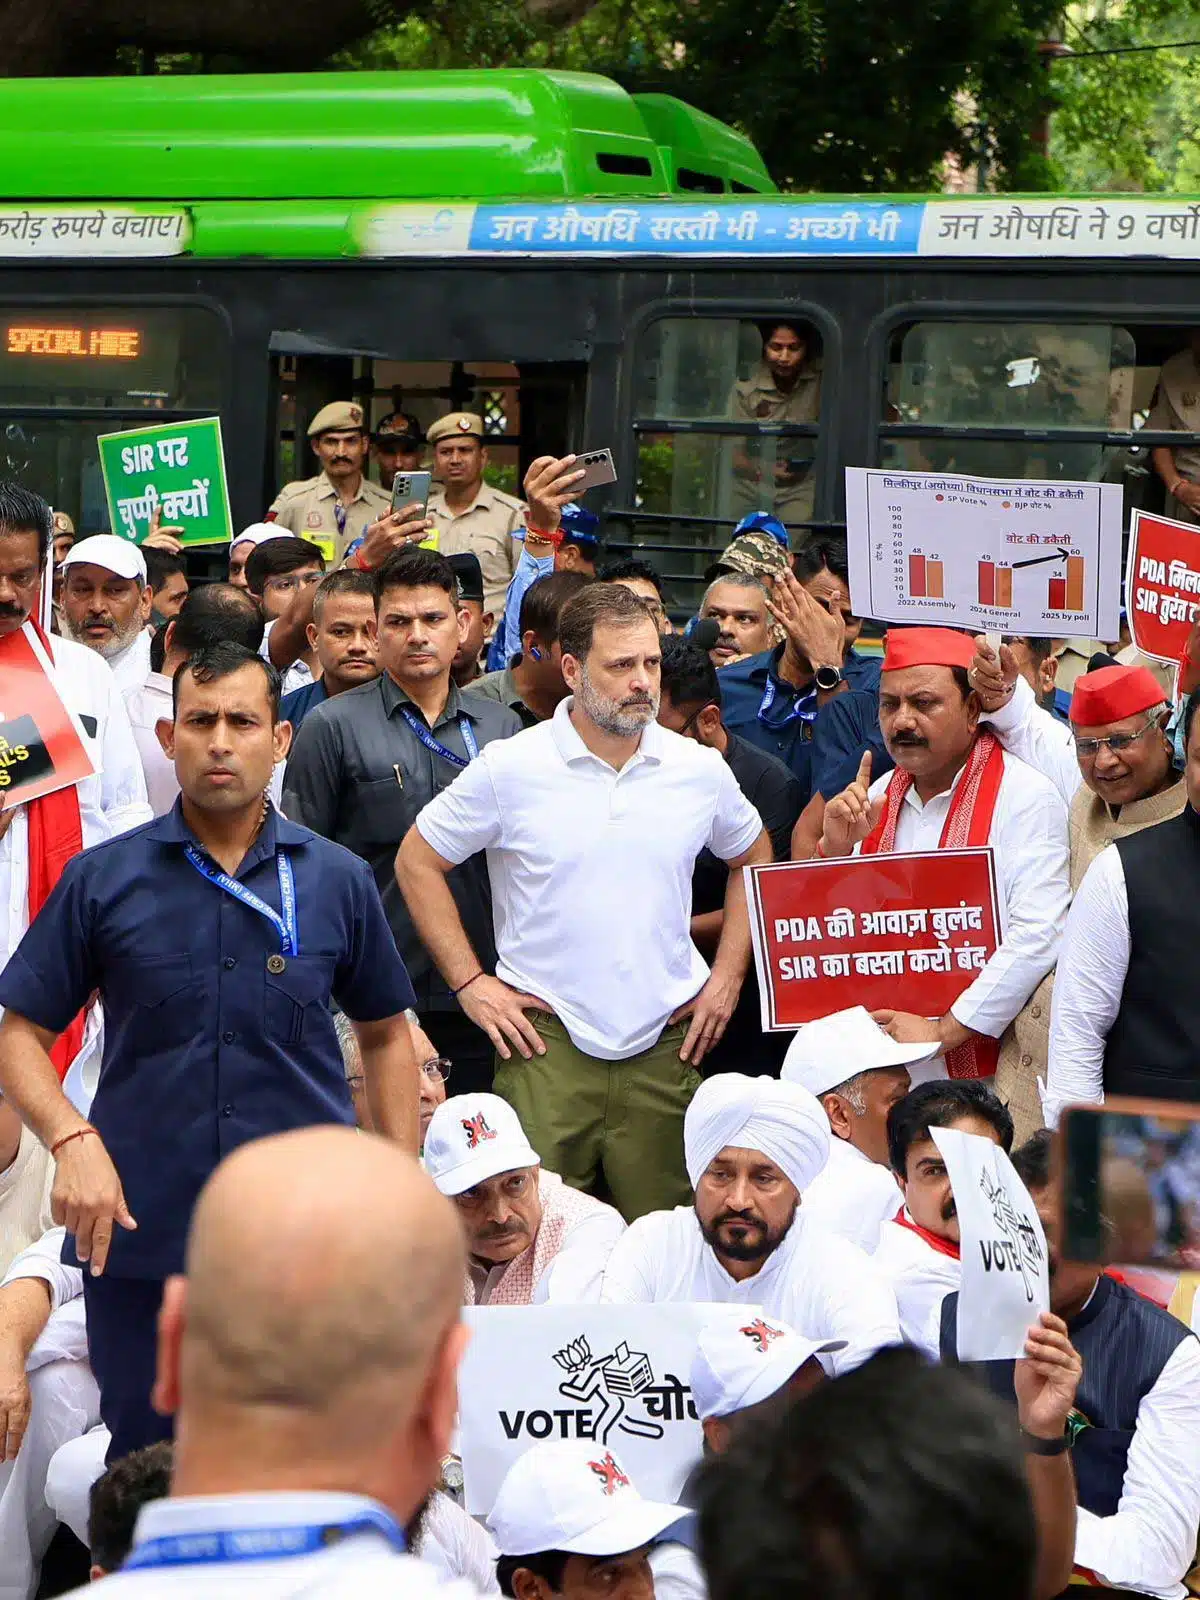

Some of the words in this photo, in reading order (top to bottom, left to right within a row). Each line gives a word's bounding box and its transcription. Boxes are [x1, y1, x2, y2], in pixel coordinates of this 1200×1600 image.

[489, 215, 538, 242] जन
[543, 208, 641, 242] औषधि
[650, 210, 721, 241] सस्ती
[726, 210, 759, 241] भी
[785, 211, 861, 241] अच्छी
[867, 211, 902, 241] भी
[938, 214, 984, 240] जन
[989, 206, 1082, 240] औषधि
[1089, 207, 1110, 240] ने
[1117, 214, 1136, 240] 9
[121, 443, 155, 475] SIR
[157, 436, 189, 468] पर
[959, 496, 978, 504] Vote
[966, 483, 1012, 497] विधानसभा
[1025, 487, 1040, 498] वोट
[1042, 488, 1055, 498] की
[1058, 488, 1084, 499] डकैती
[1014, 502, 1028, 510] BJP
[117, 484, 159, 539] चुप्पी
[161, 478, 210, 520] क्यों
[1006, 532, 1024, 543] वोट
[1026, 533, 1039, 544] की
[1138, 556, 1166, 586] PDA
[917, 600, 956, 609] Assembly
[969, 605, 987, 614] 2024
[989, 607, 1021, 618] General
[1041, 612, 1060, 620] 2025
[1062, 613, 1072, 622] by
[1074, 614, 1090, 622] poll
[1135, 587, 1159, 615] SIR
[1159, 591, 1189, 626] तुरंत
[774, 916, 823, 943] PDA
[824, 907, 856, 938] की
[860, 908, 928, 938] आवाज़
[929, 900, 983, 940] बुलंद
[778, 955, 818, 981] SIR
[819, 953, 851, 977] का
[852, 950, 905, 976] बस्ता
[907, 940, 952, 973] करो
[954, 940, 987, 970] बंद
[979, 1239, 1022, 1272] VOTE
[498, 1409, 596, 1439] VOTE
